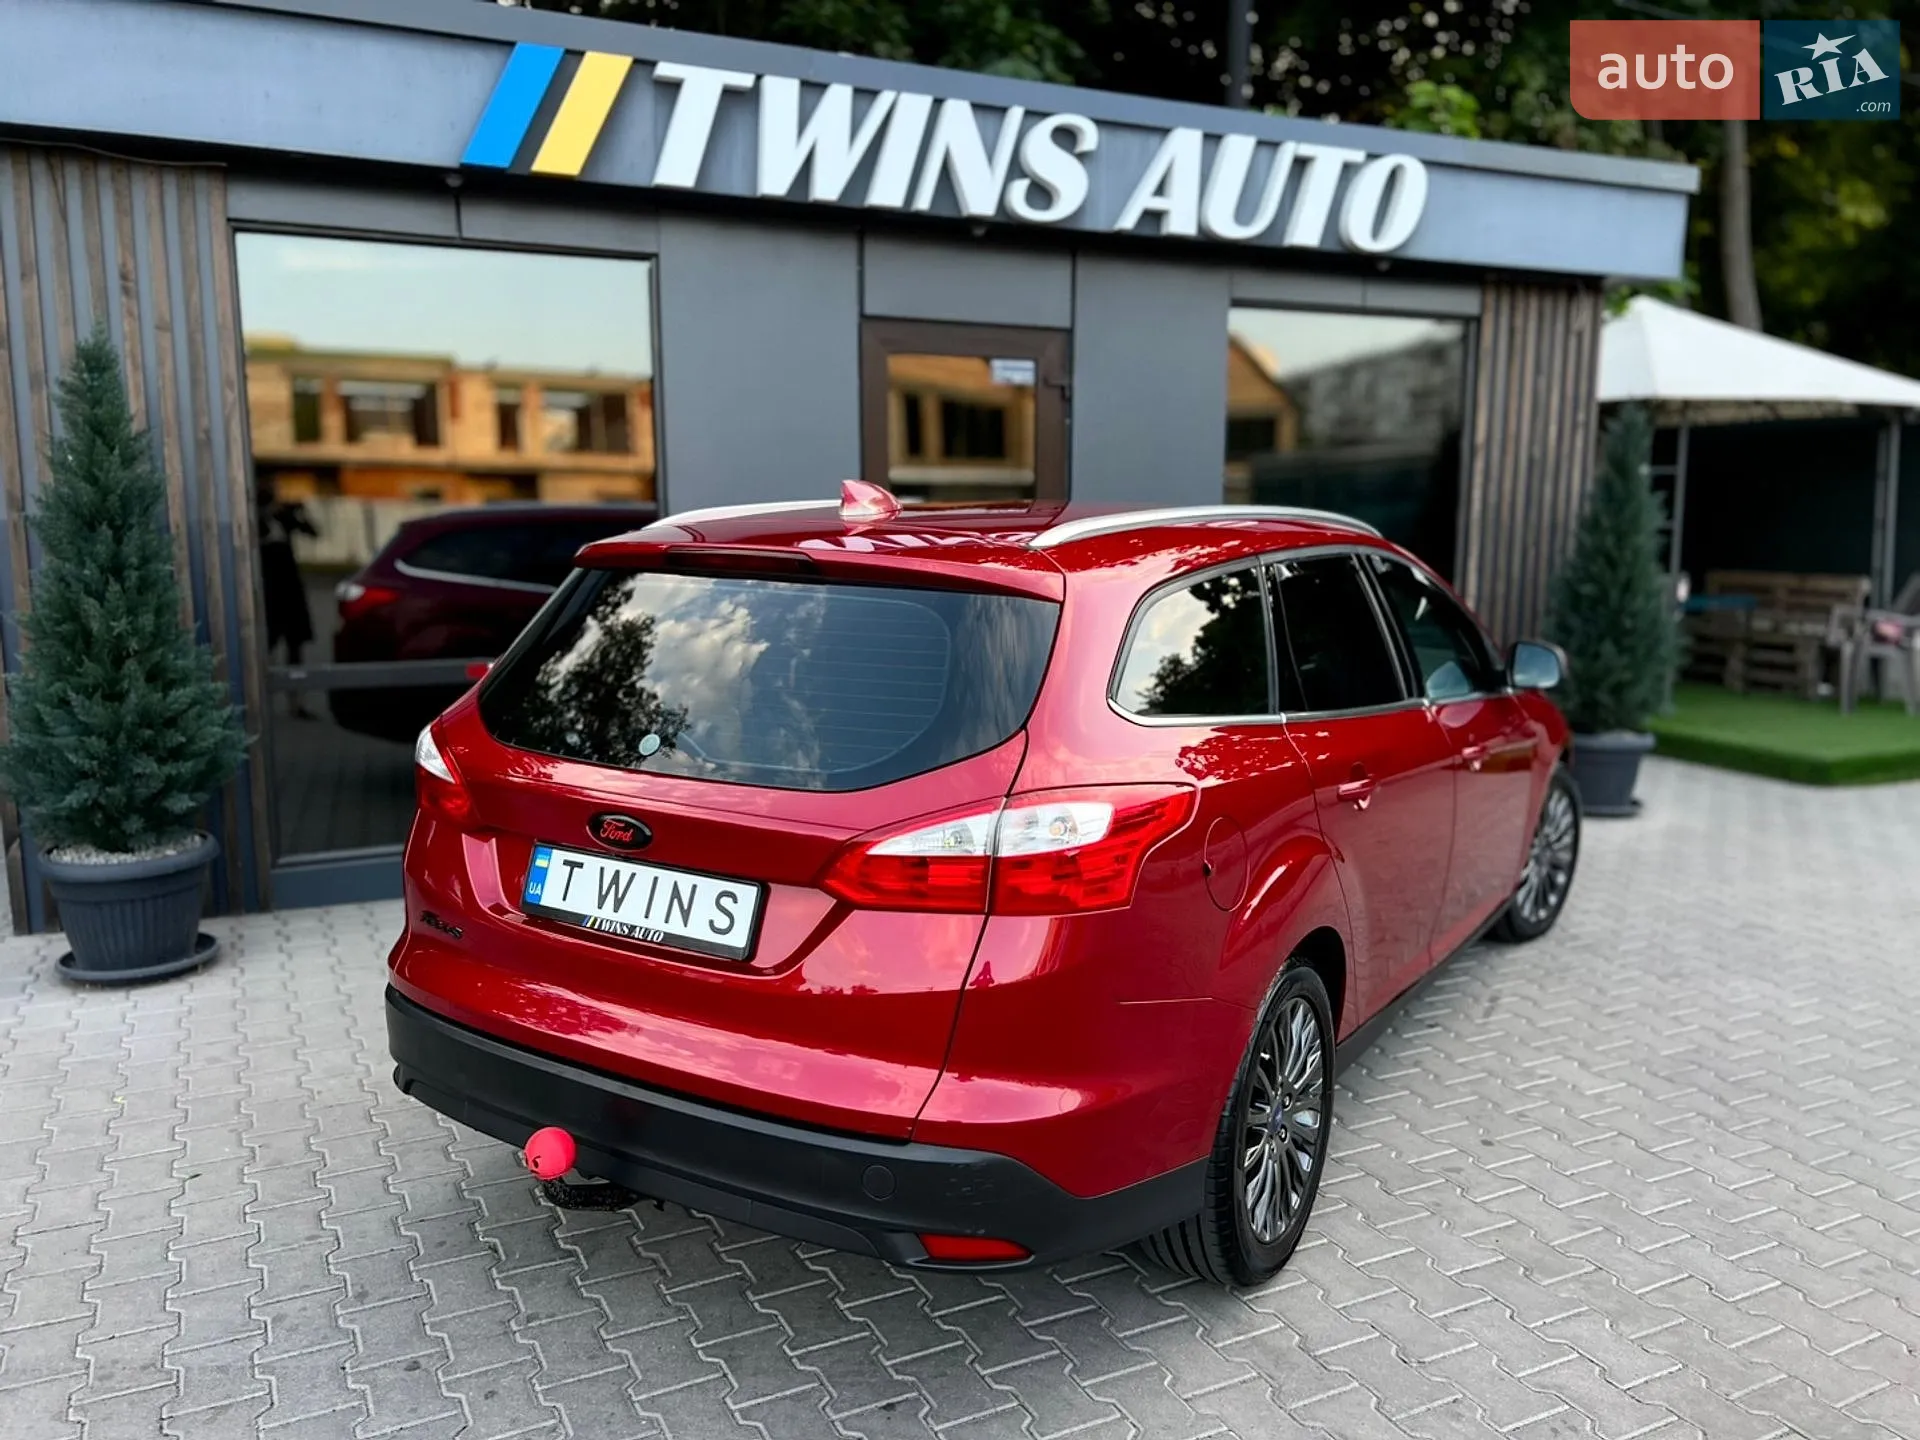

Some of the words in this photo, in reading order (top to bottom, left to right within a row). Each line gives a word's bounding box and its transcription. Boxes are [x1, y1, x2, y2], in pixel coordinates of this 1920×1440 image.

[652, 61, 1099, 225] TWINS
[1113, 127, 1429, 255] AUTO
[600, 818, 633, 842] Ford
[529, 883, 542, 896] UA
[594, 917, 630, 936] TWINS
[630, 926, 664, 943] AUTO
